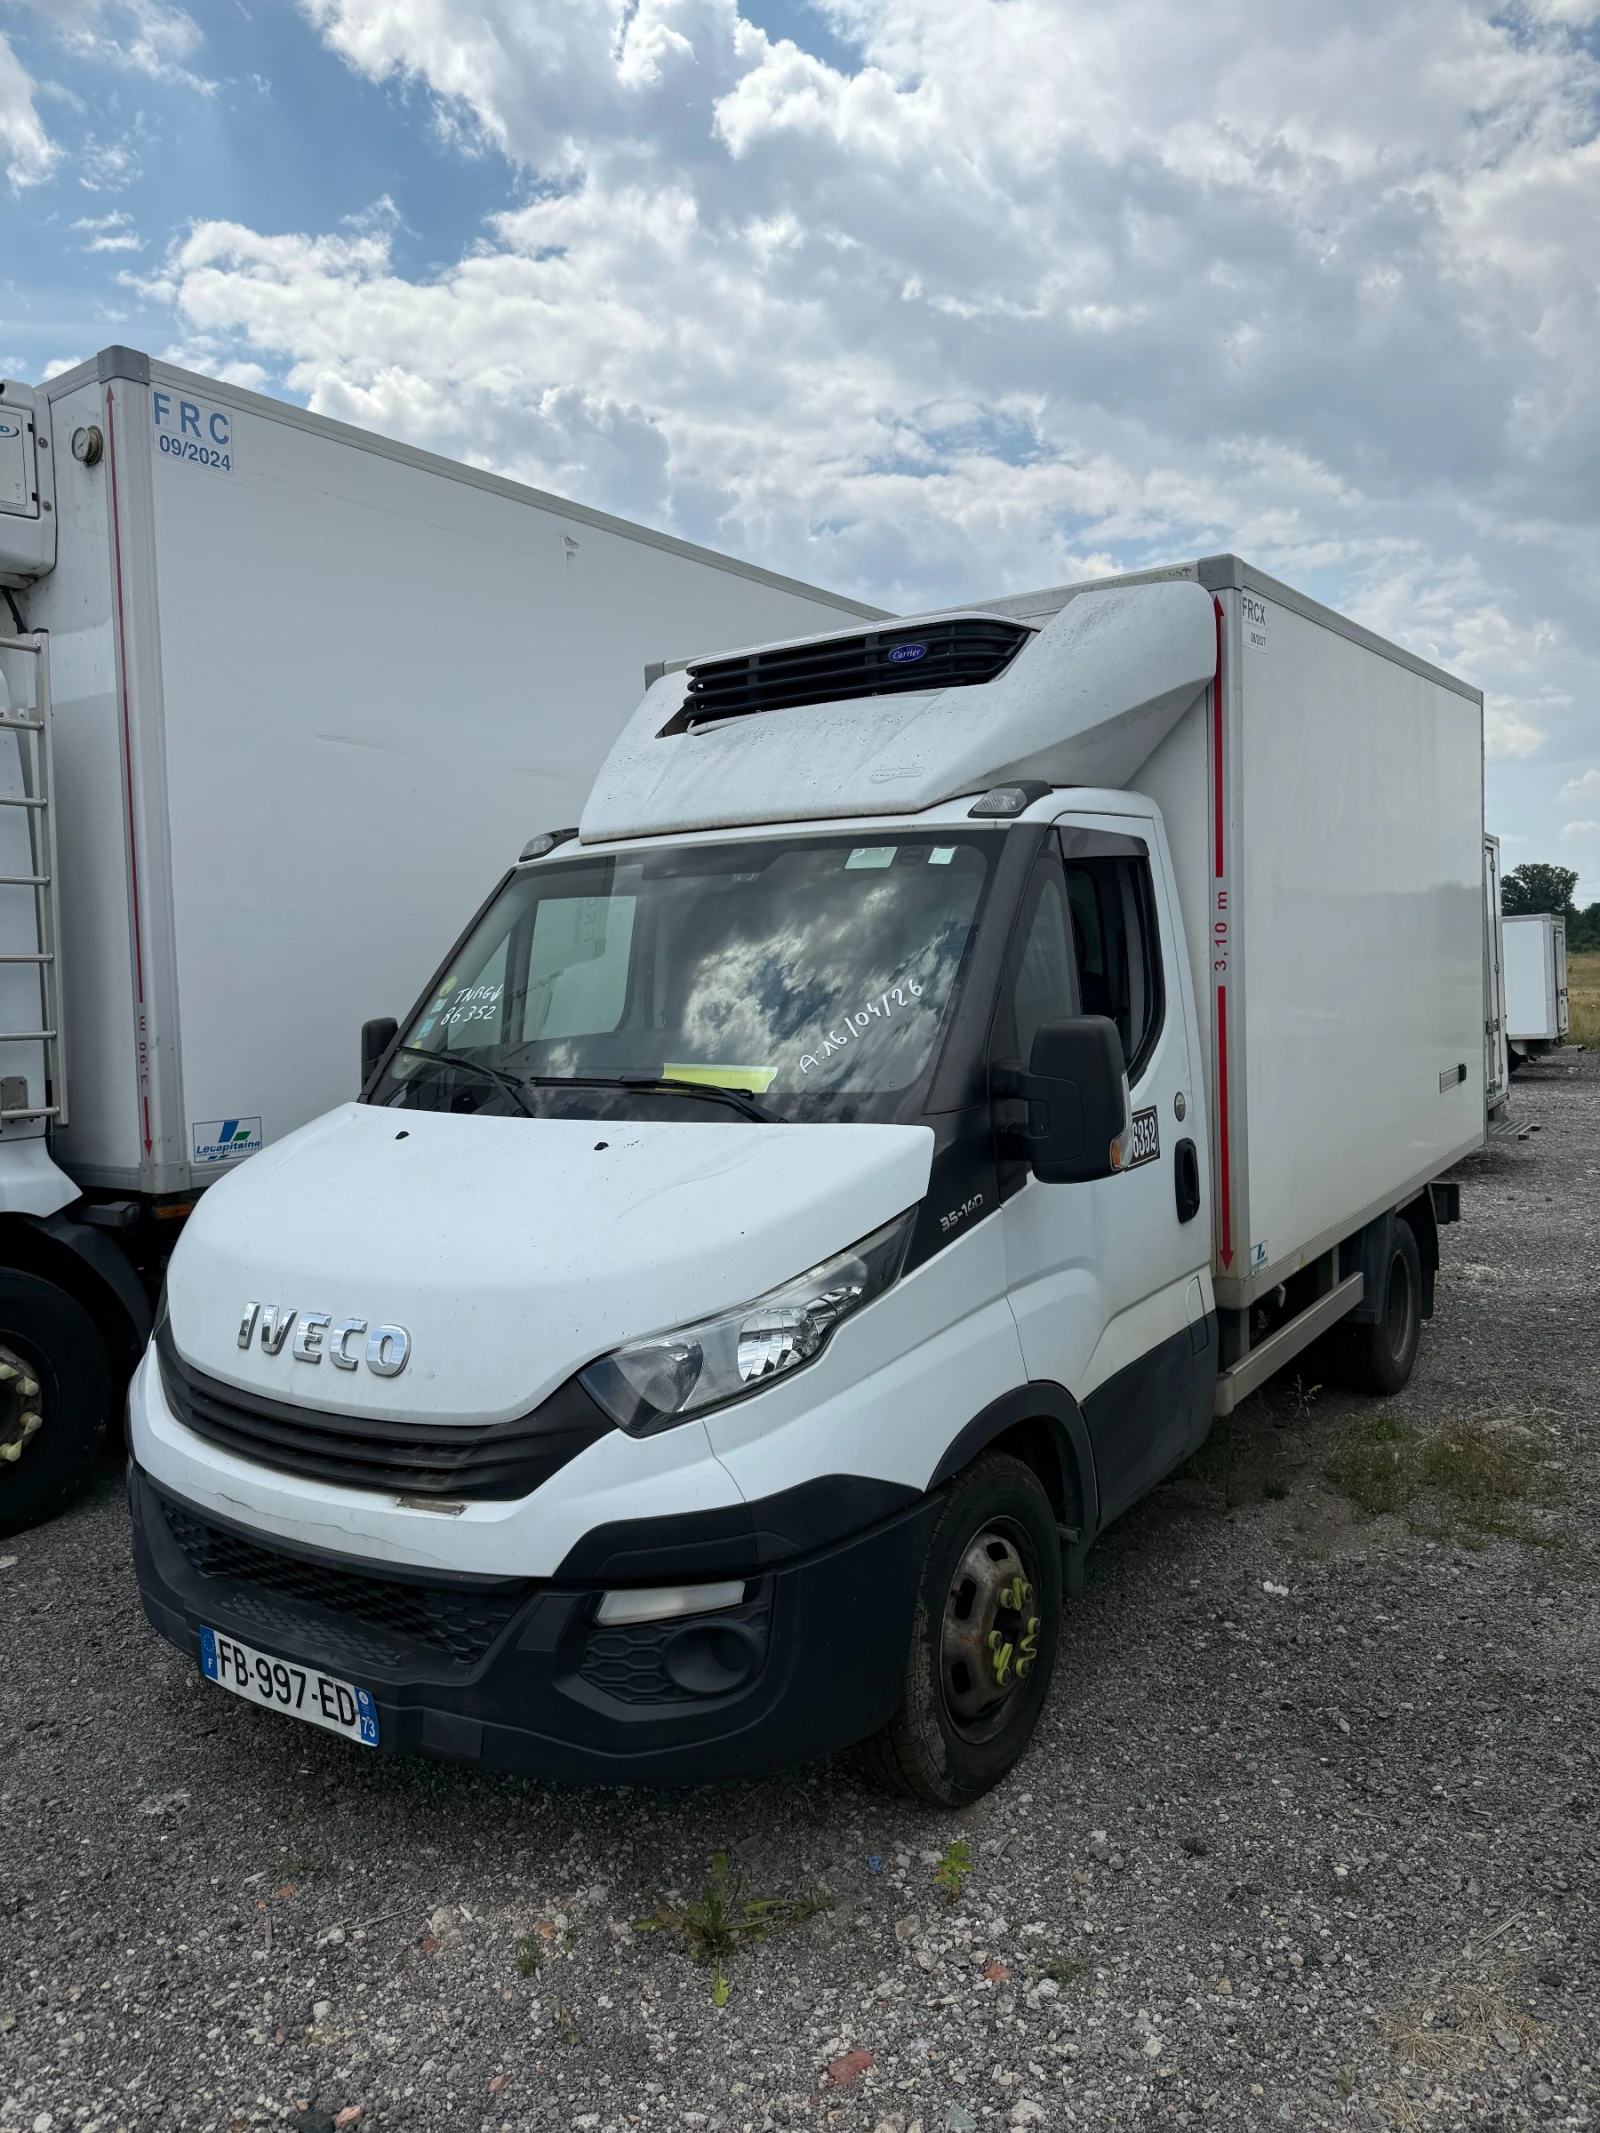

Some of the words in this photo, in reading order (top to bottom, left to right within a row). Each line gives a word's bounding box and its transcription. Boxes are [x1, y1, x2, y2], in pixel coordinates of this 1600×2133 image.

[159, 435, 231, 471] 09/2024
[1242, 596, 1266, 625] FRCX
[892, 649, 921, 660] Carrier
[1217, 891, 1228, 910] m
[1213, 922, 1229, 972] 3,10
[196, 1140, 261, 1155] Lecapitaine
[1132, 1116, 1157, 1158] 6352
[237, 1301, 412, 1378] IVECO
[208, 1658, 214, 1669] F
[218, 1638, 357, 1727] FB-997-ED
[361, 1716, 376, 1738] 73
